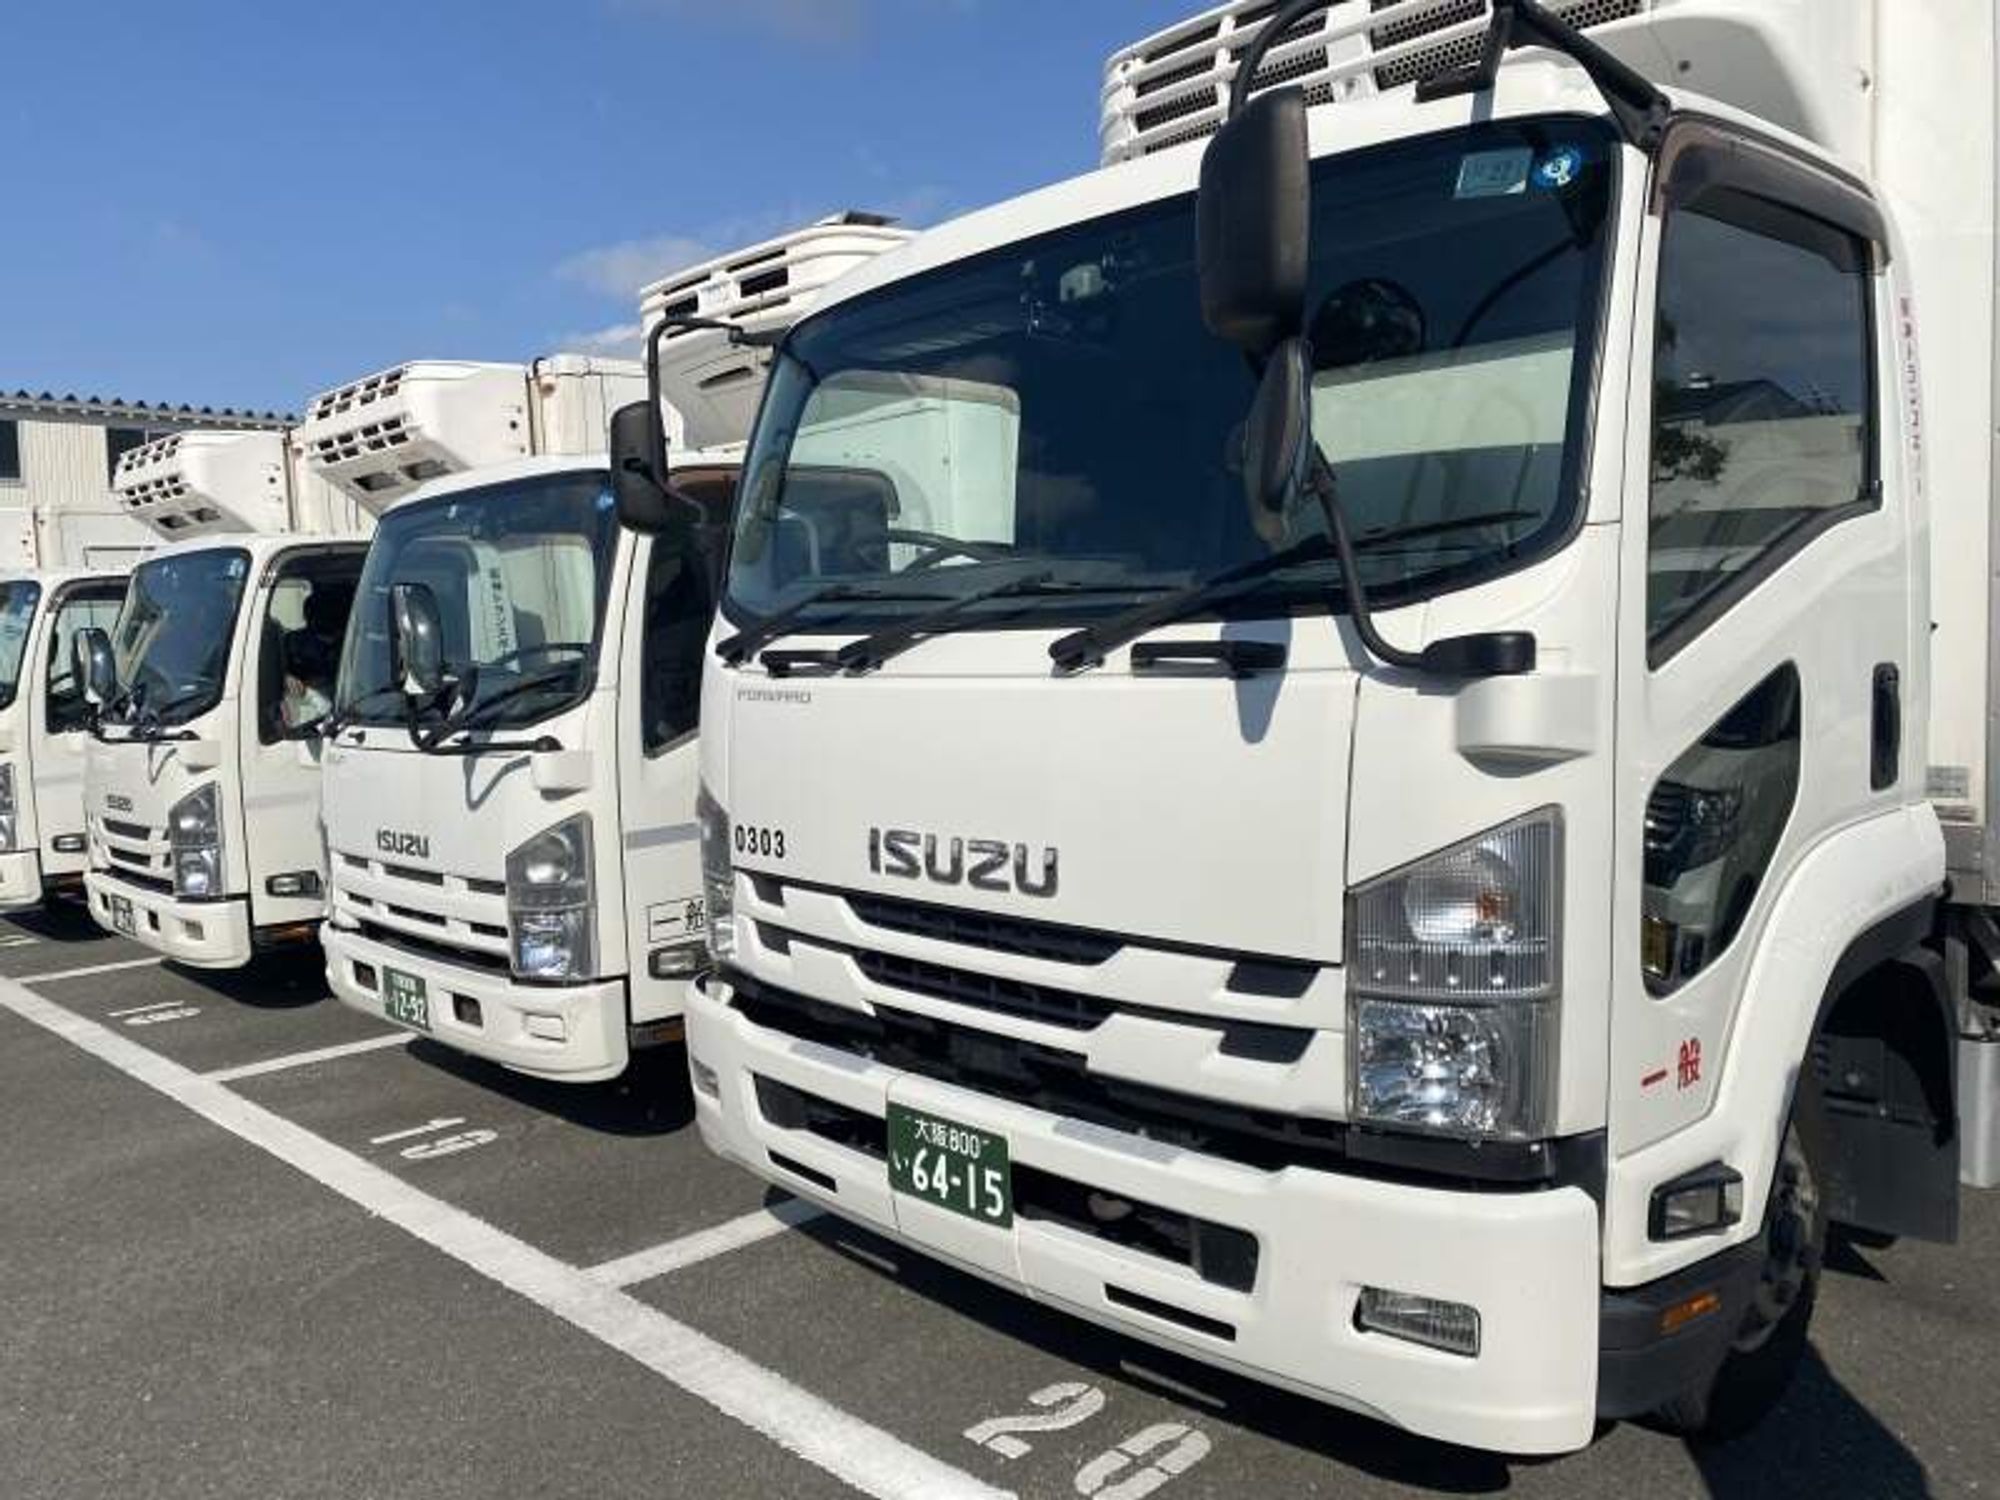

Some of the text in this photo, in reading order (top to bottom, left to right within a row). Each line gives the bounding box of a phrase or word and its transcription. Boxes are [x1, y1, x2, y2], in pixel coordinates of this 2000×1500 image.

[377, 828, 429, 859] ISUZU
[734, 825, 785, 858] 0303
[869, 827, 1057, 898] ISUZU
[1641, 1036, 1701, 1091] 一般
[914, 1118, 981, 1159] 大阪800
[912, 1147, 1004, 1218] 64-15
[962, 1381, 1212, 1500] 20
